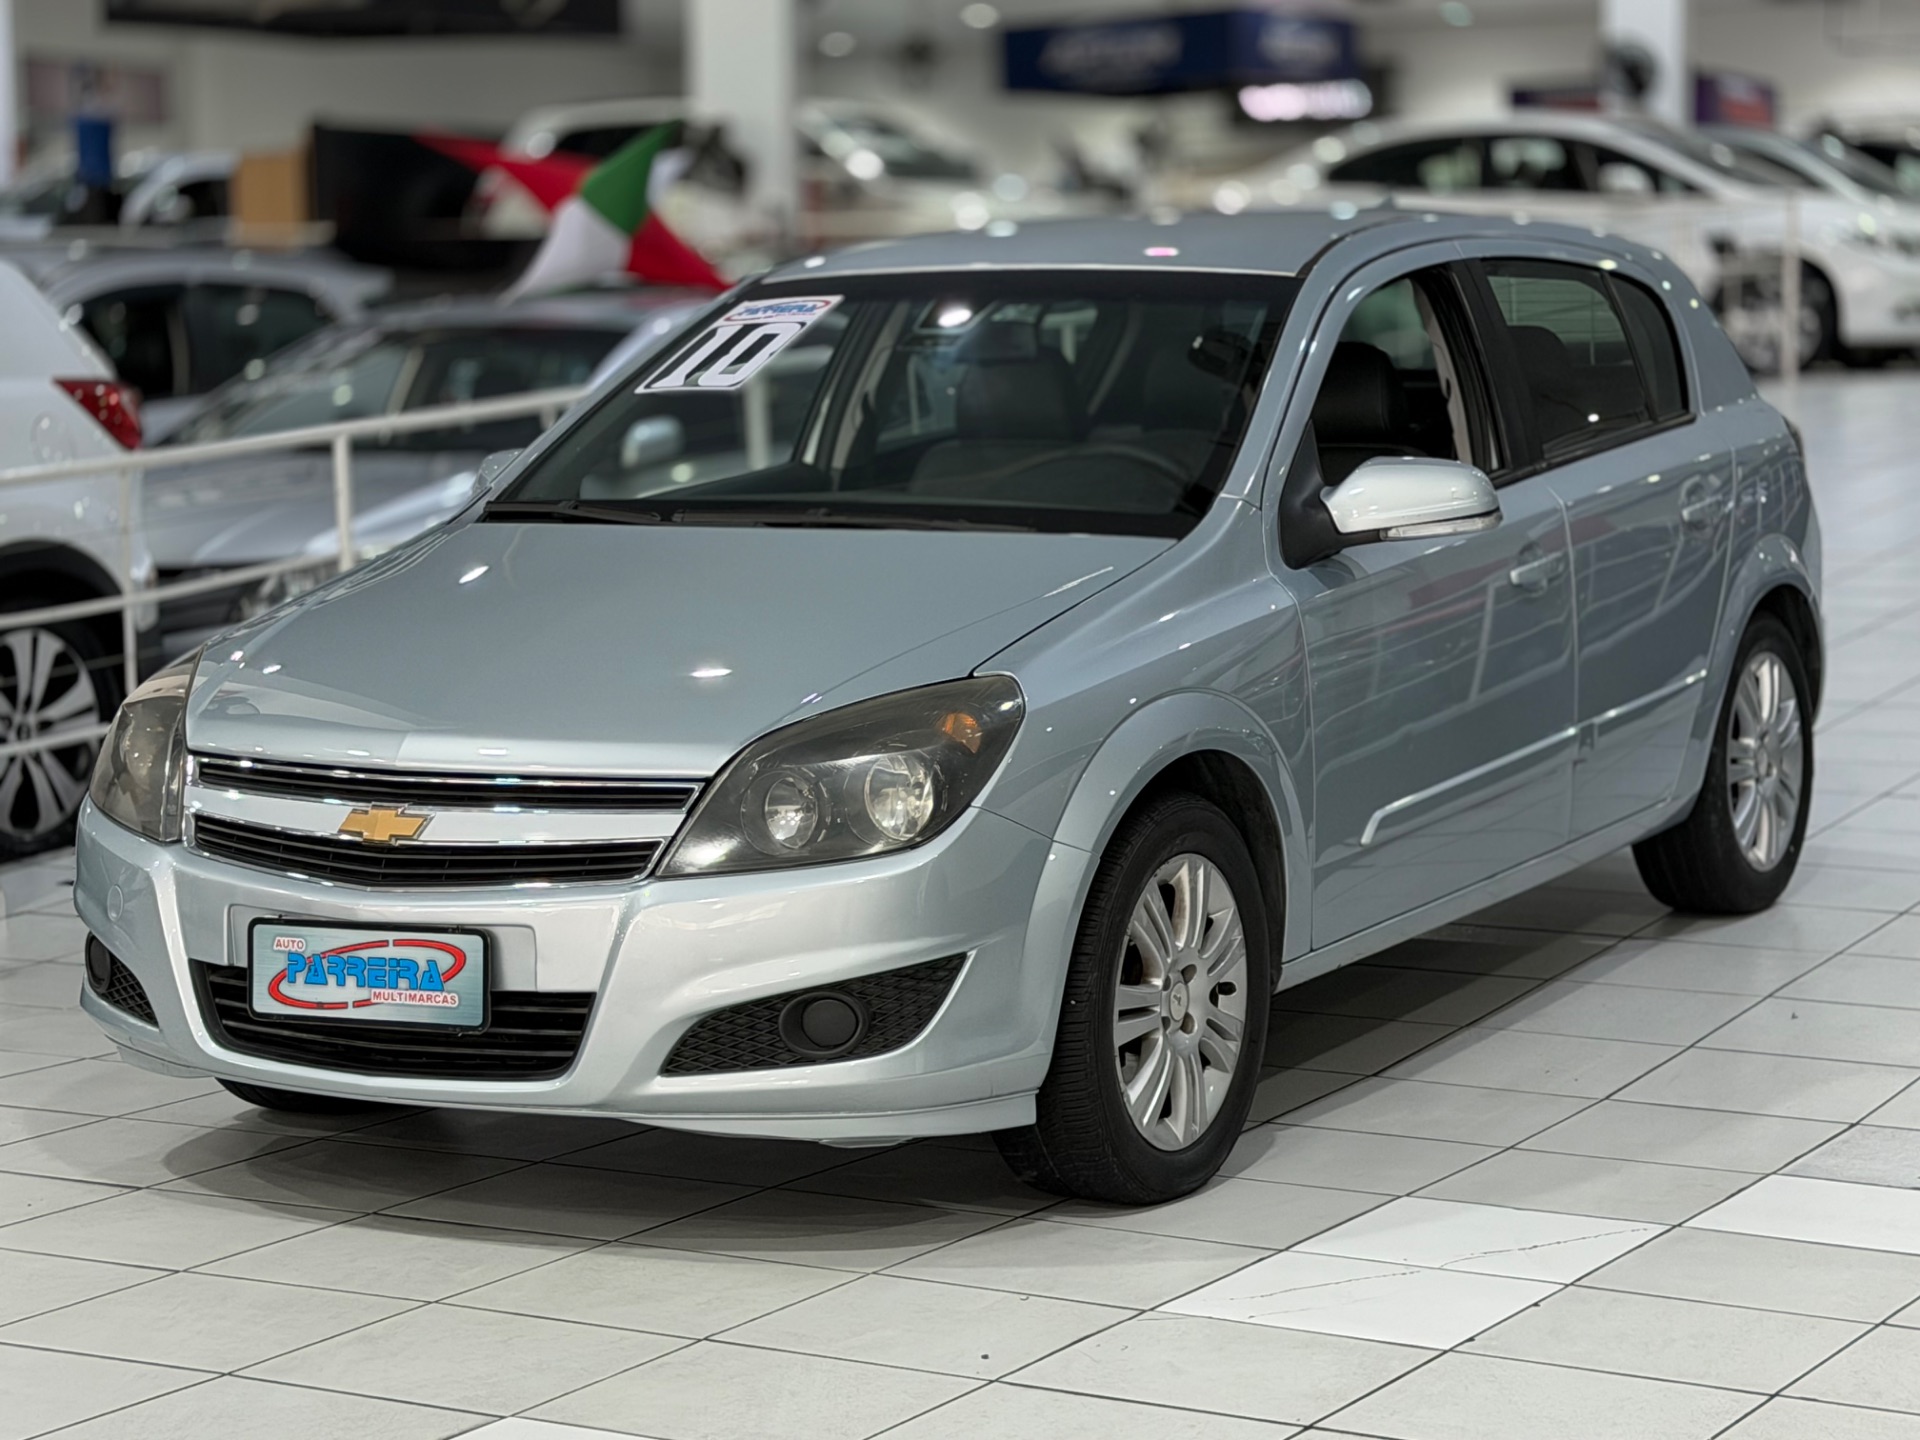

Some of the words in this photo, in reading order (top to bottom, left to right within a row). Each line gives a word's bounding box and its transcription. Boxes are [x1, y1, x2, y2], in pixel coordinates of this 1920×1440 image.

[651, 322, 802, 387] 10
[275, 938, 304, 950] AUTO
[287, 952, 444, 991] PARREIRA
[372, 991, 457, 1005] MULTIMARCAS
